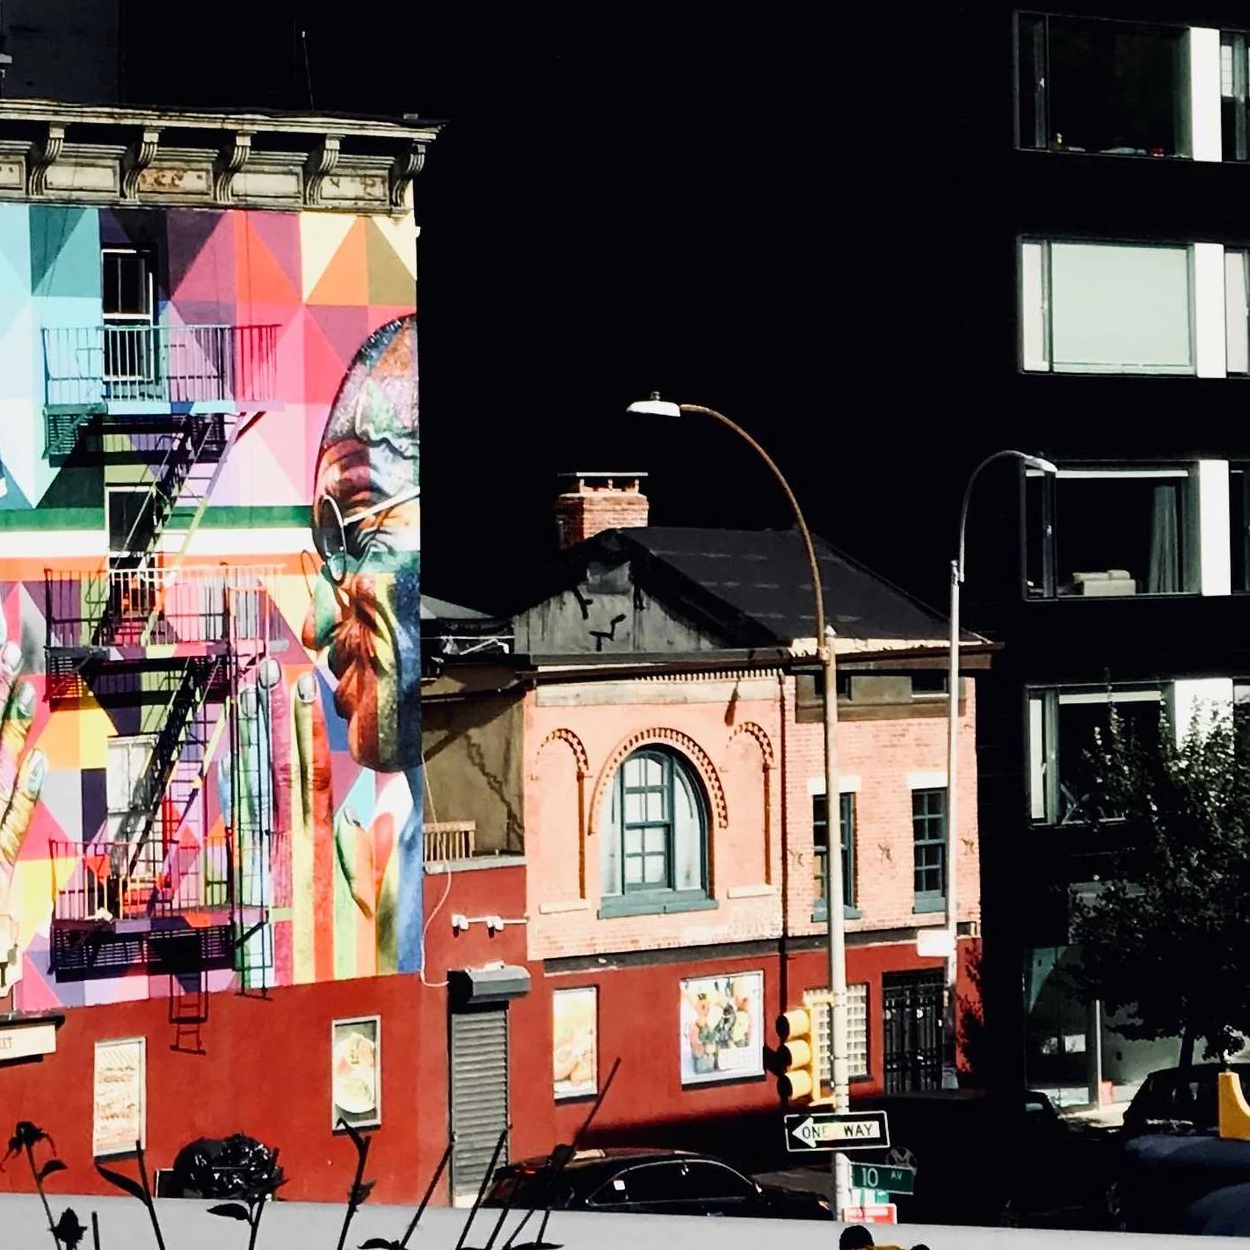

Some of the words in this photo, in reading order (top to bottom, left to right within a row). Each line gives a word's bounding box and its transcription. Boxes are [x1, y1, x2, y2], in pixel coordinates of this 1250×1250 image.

[802, 1124, 830, 1139] ONE
[843, 1123, 873, 1137] WAY
[862, 1167, 879, 1187] 10
[891, 1172, 903, 1181] AV
